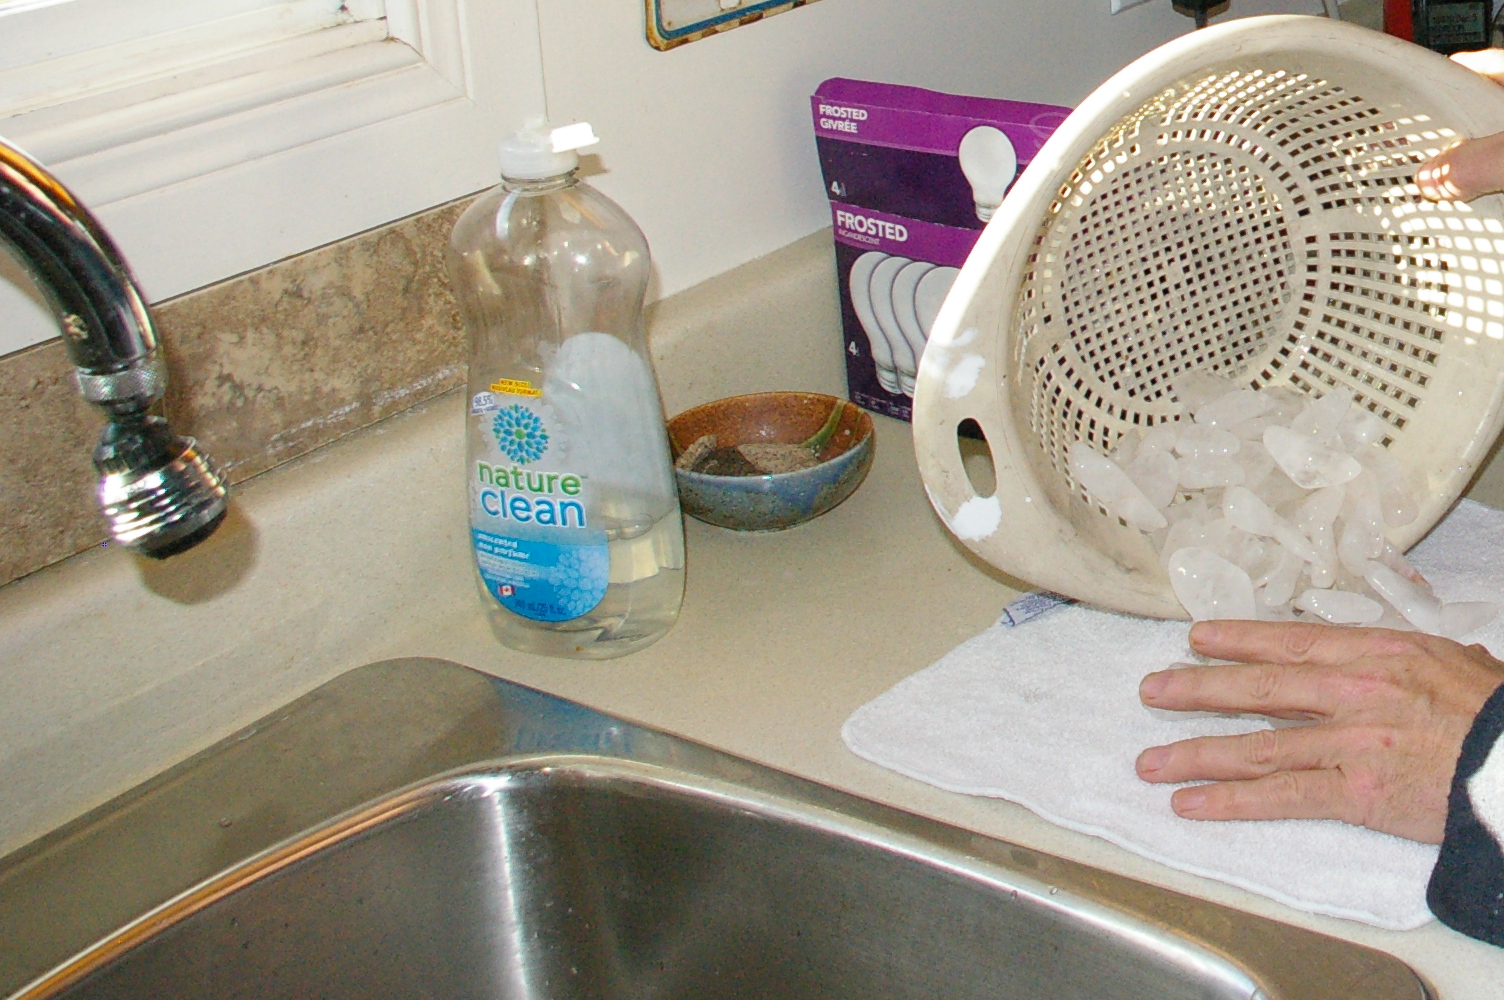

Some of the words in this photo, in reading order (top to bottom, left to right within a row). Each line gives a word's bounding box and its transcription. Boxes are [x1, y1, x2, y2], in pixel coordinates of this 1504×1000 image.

[819, 104, 868, 120] FROSTED
[820, 117, 858, 133] GIVRÉE
[831, 180, 840, 196] 4
[836, 209, 908, 242] FROSTED
[848, 340, 857, 356] 4
[477, 461, 582, 496] nature
[480, 489, 587, 528] clean
